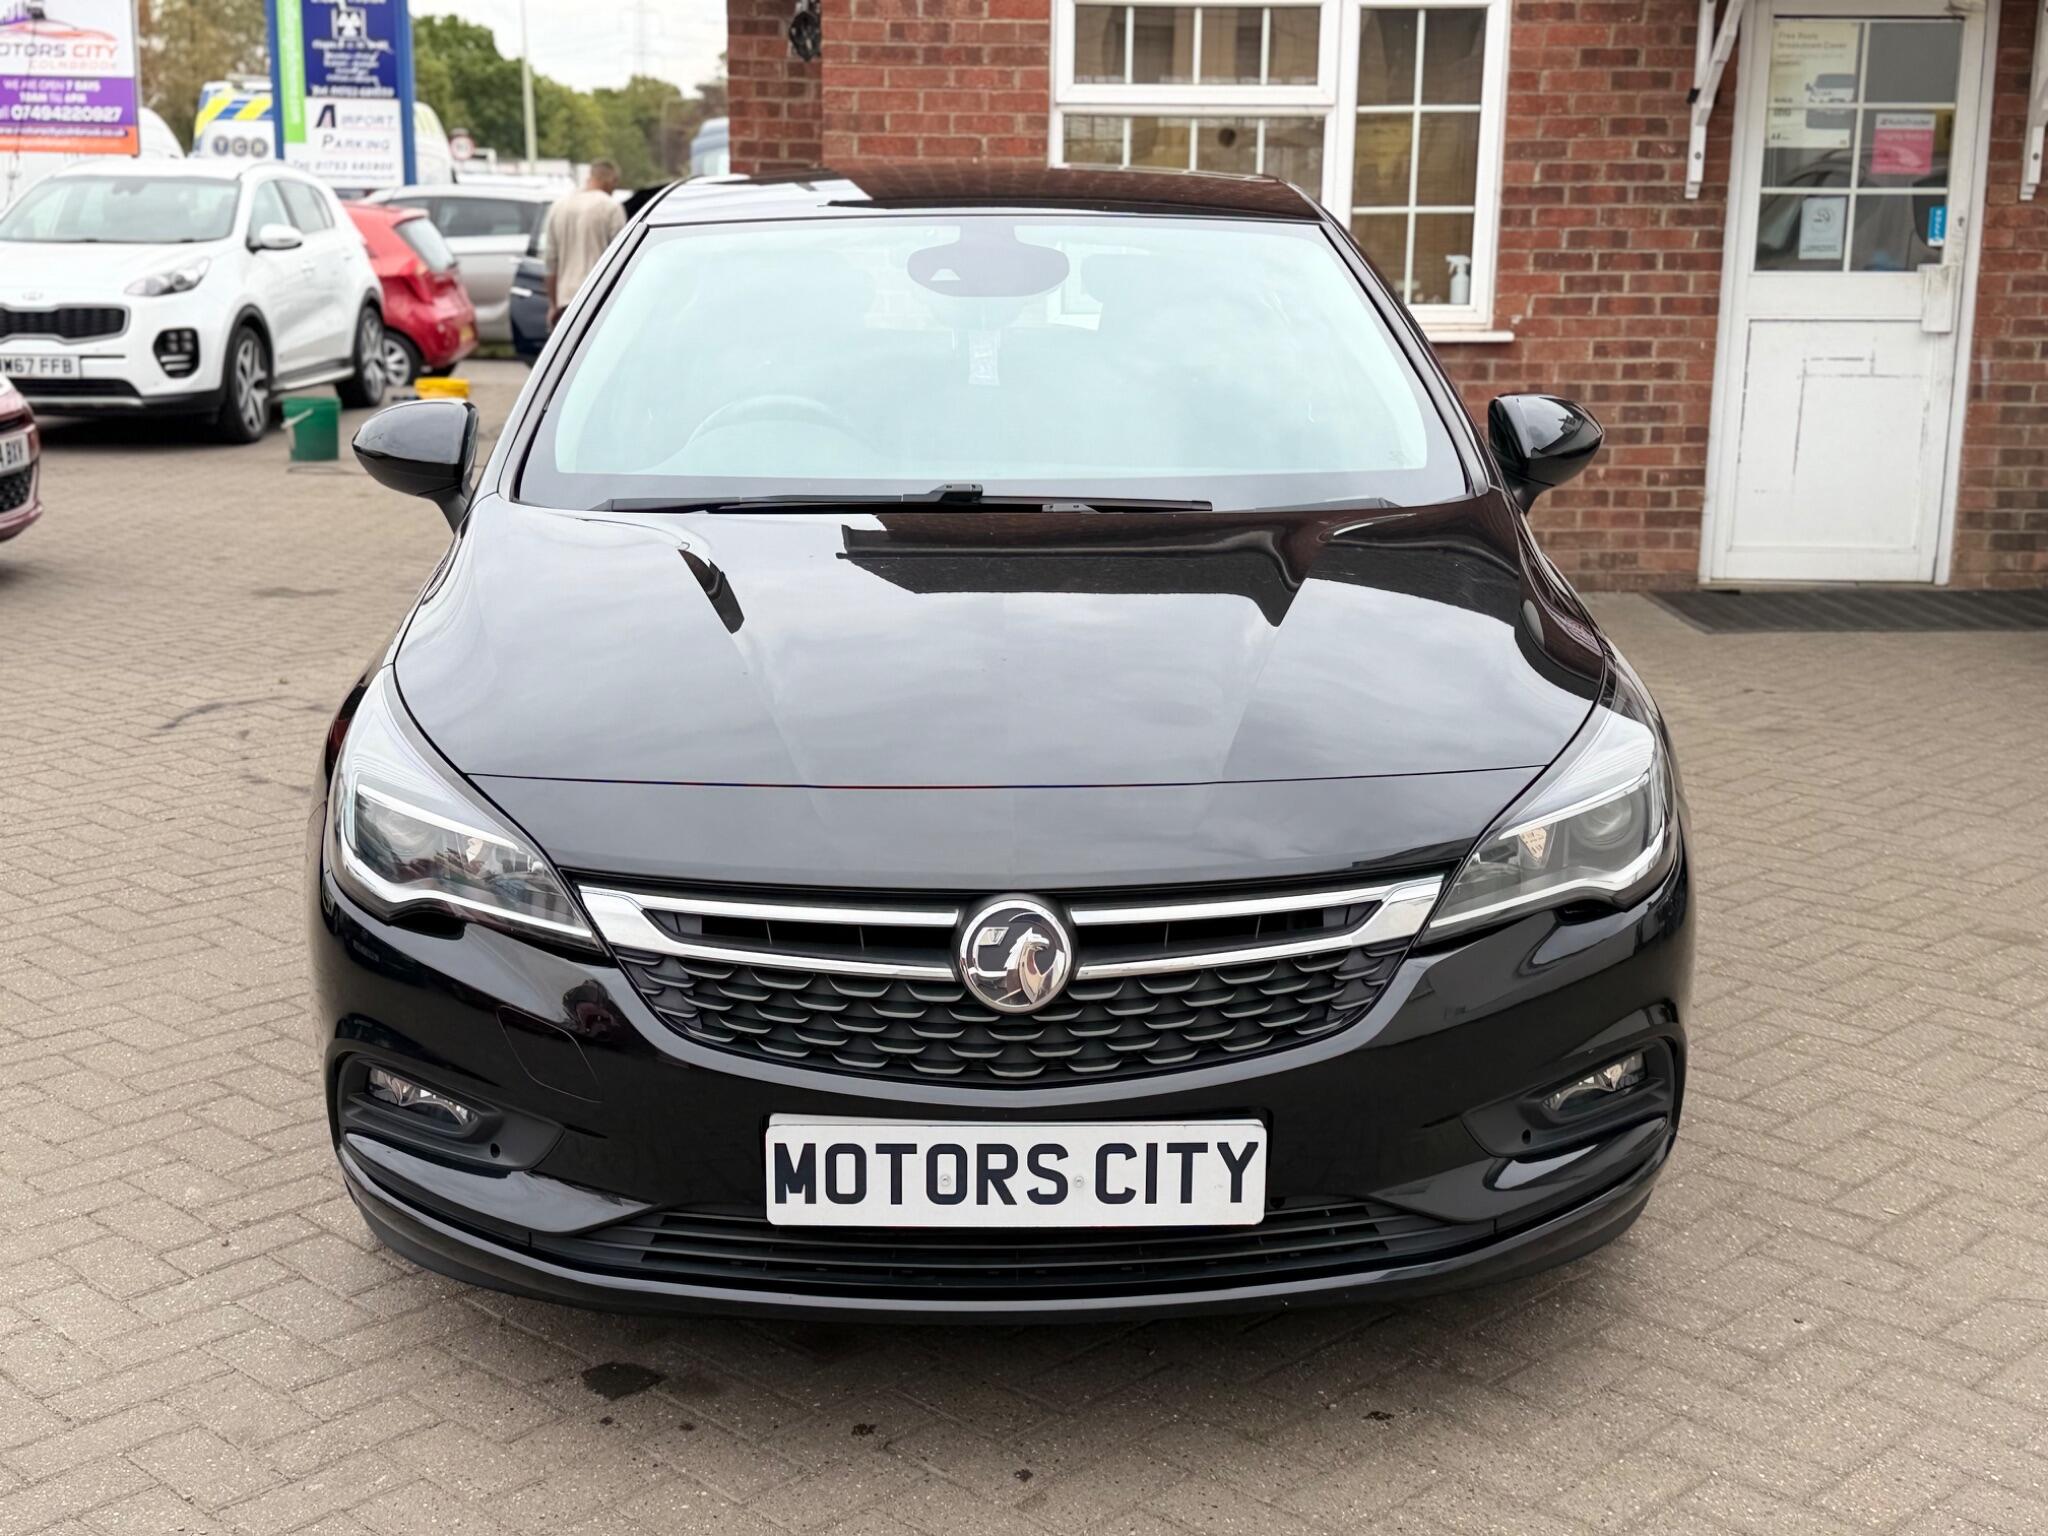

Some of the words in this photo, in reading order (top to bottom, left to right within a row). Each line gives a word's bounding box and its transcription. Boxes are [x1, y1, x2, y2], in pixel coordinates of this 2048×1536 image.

[72, 43, 118, 59] CITY
[315, 104, 394, 129] AIRPORT
[321, 133, 390, 151] PARKING
[40, 357, 73, 374] FFB
[774, 1142, 1069, 1206] MOTORS
[1095, 1141, 1260, 1206] CITY
